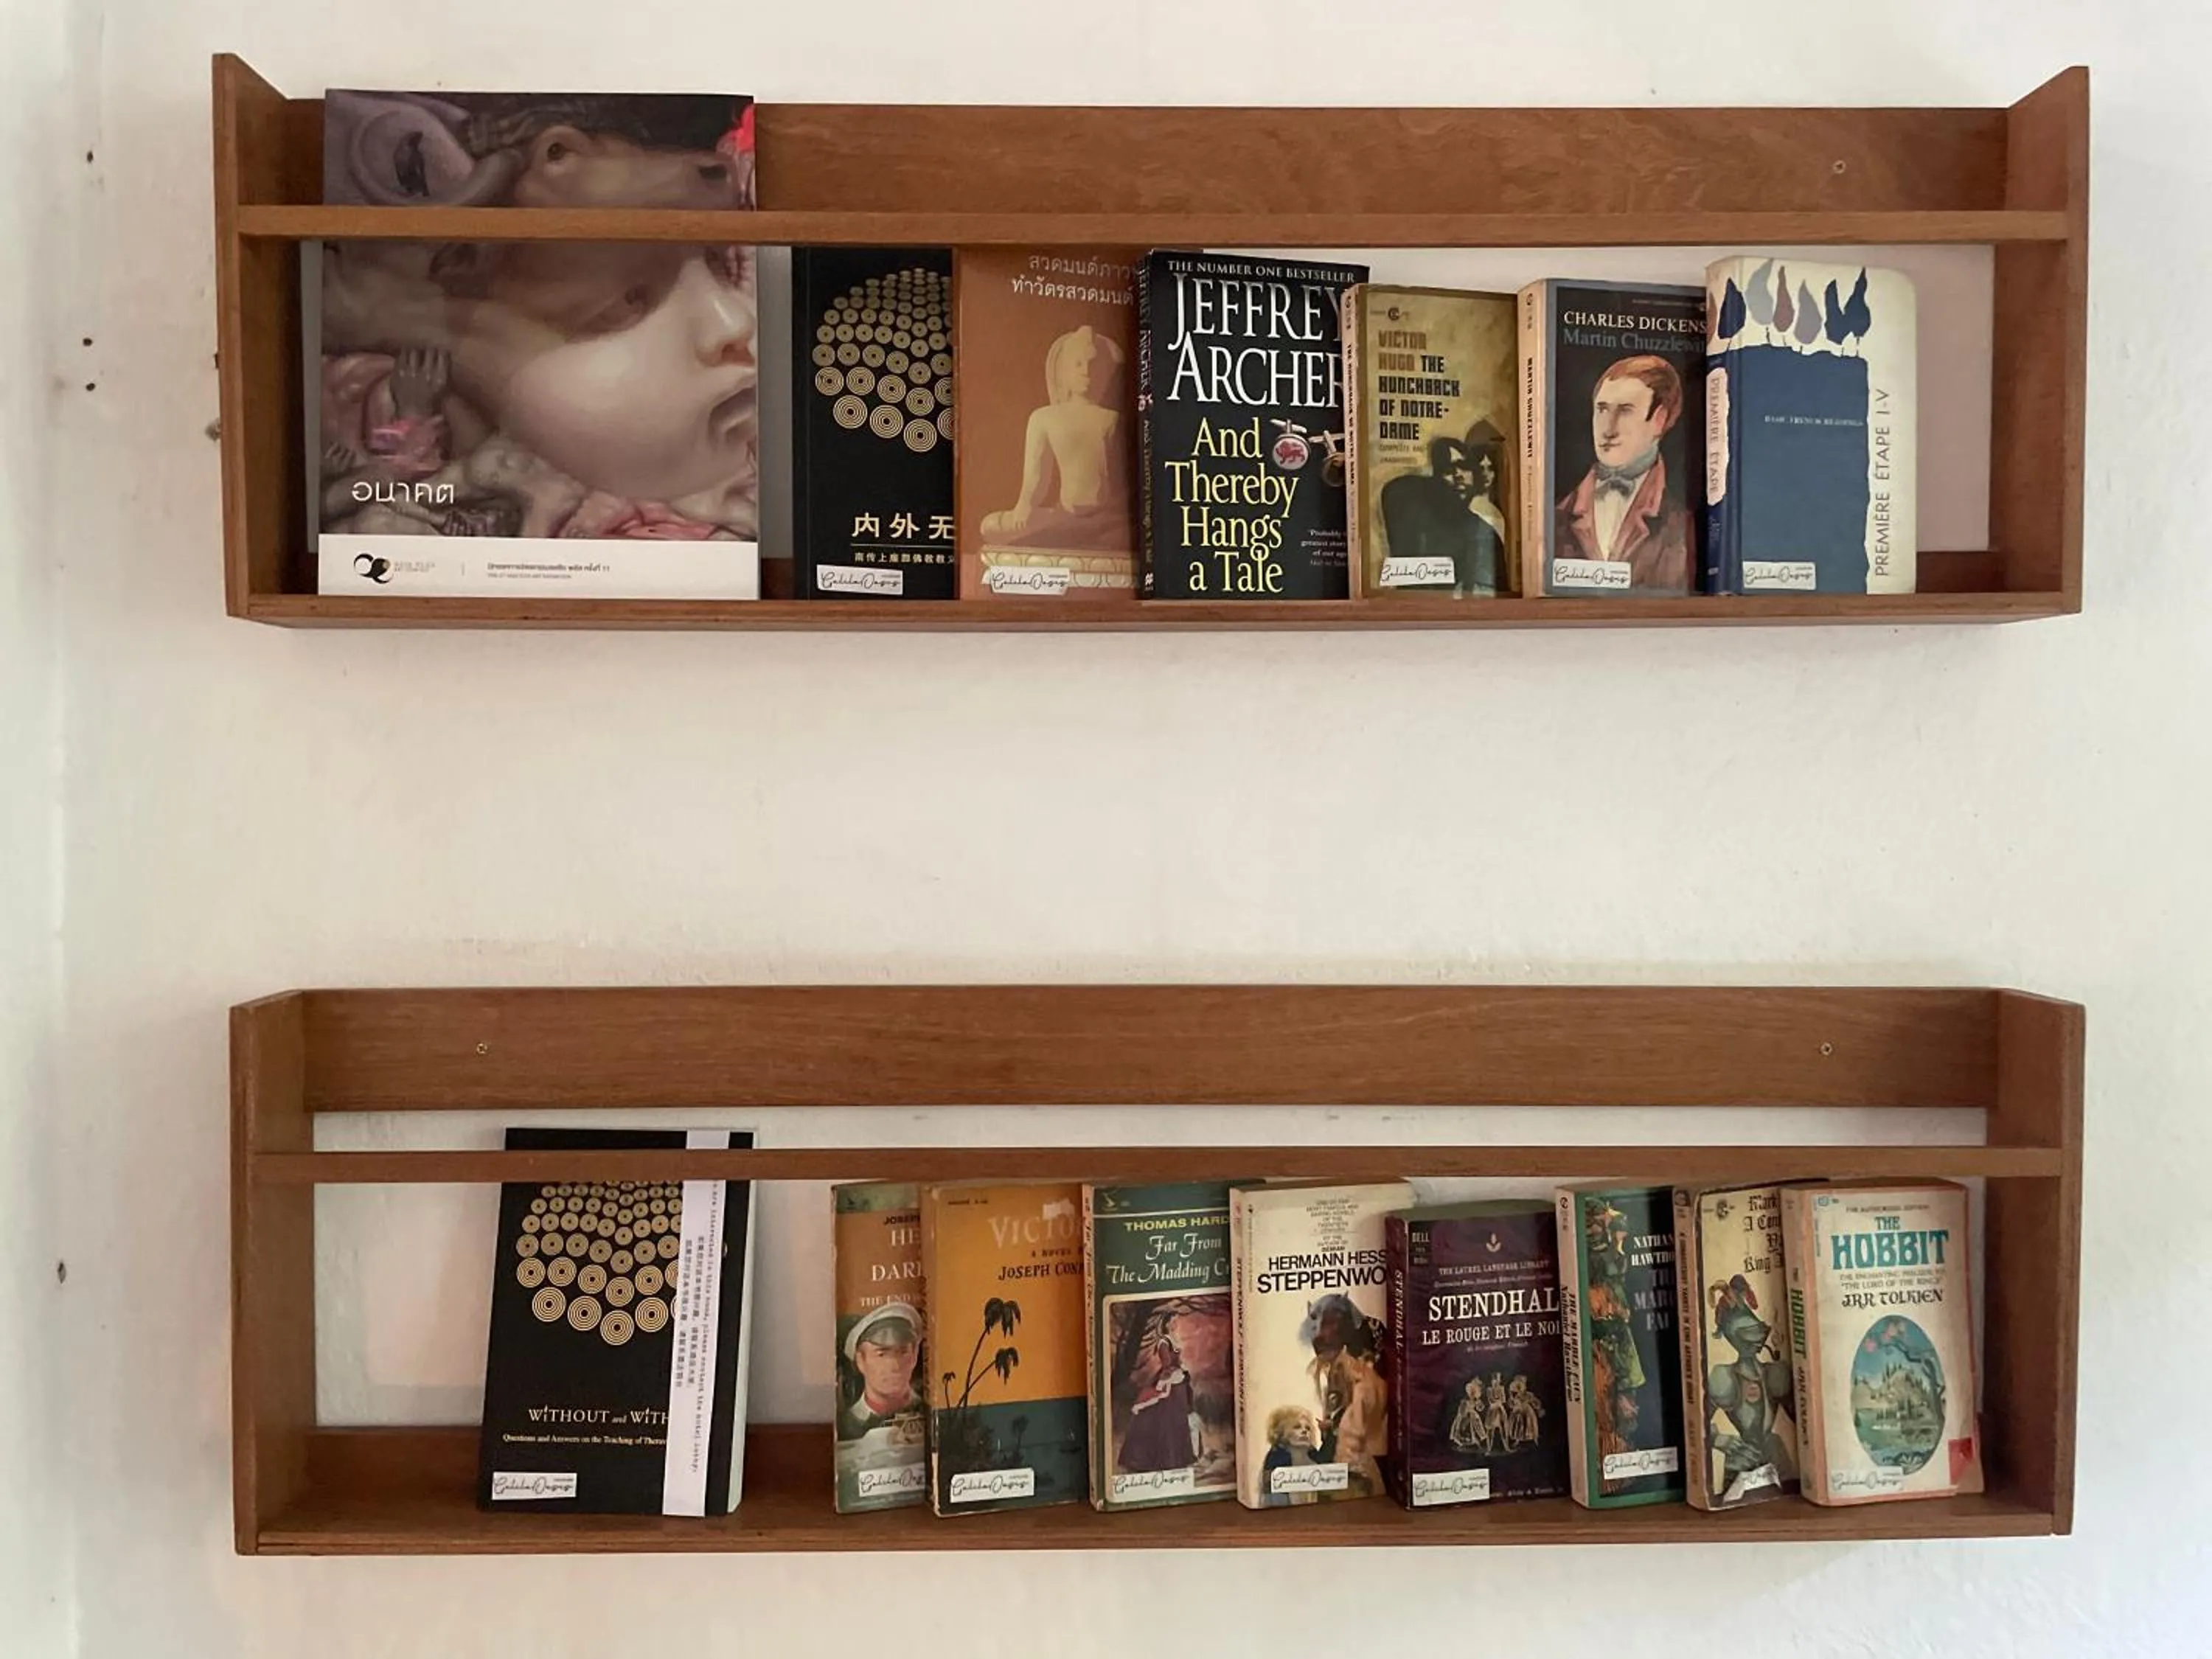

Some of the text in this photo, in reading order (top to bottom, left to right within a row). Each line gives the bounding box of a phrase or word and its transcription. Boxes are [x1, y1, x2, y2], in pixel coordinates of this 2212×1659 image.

[1168, 260, 1356, 283] THE NUMBER ONE BESTSELLER
[1564, 310, 1706, 333] CHARLES DICKENS
[1378, 330, 1427, 350] VICTOR
[1563, 328, 1616, 348] Martin
[1378, 352, 1444, 373] HUGO THE
[1379, 376, 1461, 397] HUNCHBACK
[1380, 399, 1395, 417] OF
[1191, 417, 1263, 458] And
[1380, 421, 1419, 440] DAME
[352, 481, 454, 504] อนาคต
[1164, 459, 1300, 518] Thereby
[852, 512, 955, 539] 内外无
[1180, 506, 1282, 562] Hangs
[1189, 549, 1283, 592] a Tale
[1124, 1218, 1186, 1232] THOMAS
[1874, 1216, 1900, 1231] THE
[1145, 1233, 1222, 1261] Far From
[1831, 1229, 1949, 1270] HOBBIT
[998, 1264, 1050, 1281] JOSEPH
[1107, 1261, 1210, 1284] The Madding
[1268, 1252, 1344, 1272] HERMANN
[1257, 1266, 1387, 1294] STEPPENWO
[1429, 1287, 1559, 1323] STENDHAL
[1879, 1289, 1943, 1307] TOLKIEN
[1395, 1269, 1405, 1351] STENDHAL
[1422, 1330, 1440, 1346] LE
[1446, 1326, 1490, 1344] ROUGE
[1495, 1324, 1512, 1340] ET
[1516, 1322, 1533, 1338] LE
[611, 1415, 627, 1424] and
[503, 1433, 536, 1443] Questions
[537, 1435, 550, 1443] and
[551, 1435, 580, 1443] Answers
[603, 1436, 633, 1446] Teaching
